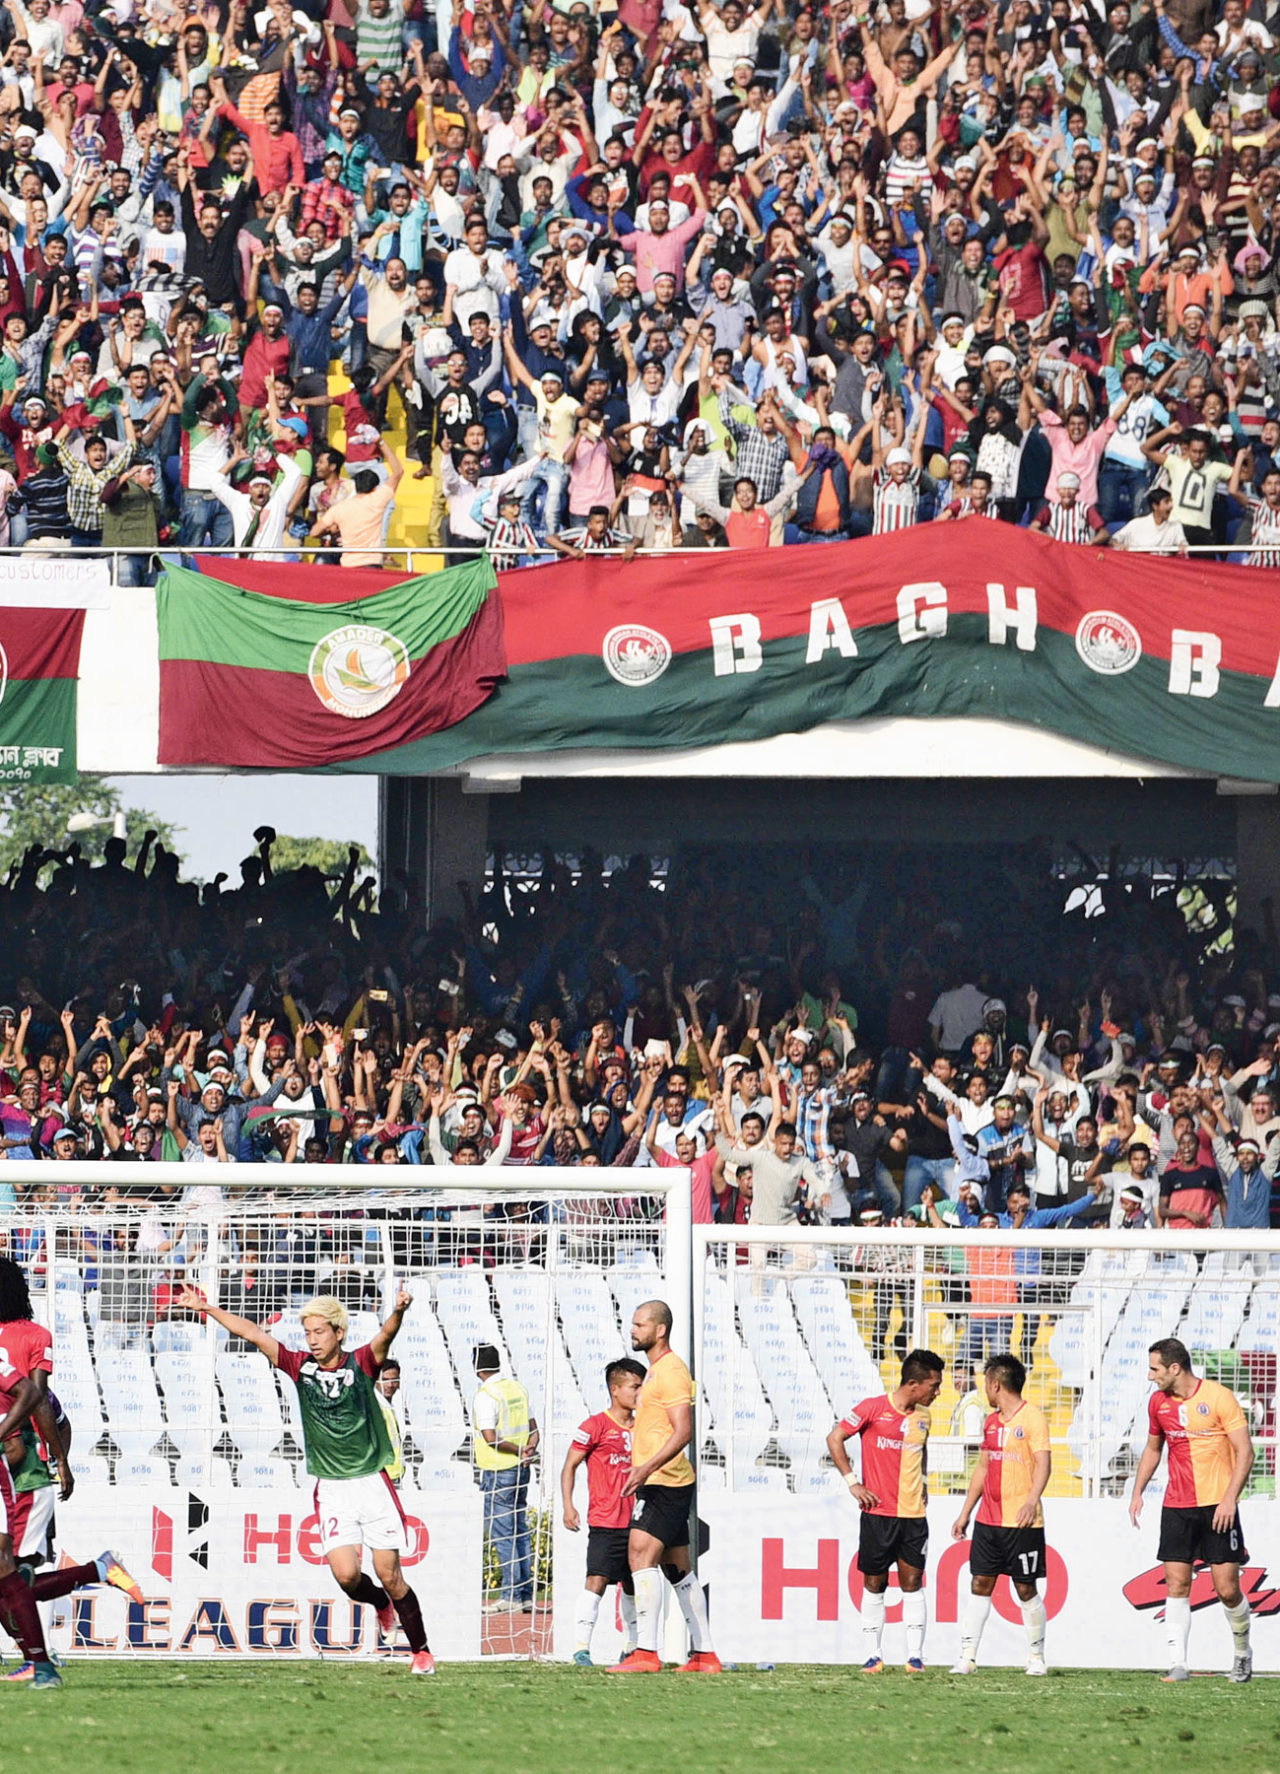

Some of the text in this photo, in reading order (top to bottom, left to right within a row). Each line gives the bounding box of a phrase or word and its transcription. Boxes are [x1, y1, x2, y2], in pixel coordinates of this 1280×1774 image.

[708, 582, 1038, 678] BAGH
[899, 1417, 909, 1436] 4
[1178, 1404, 1189, 1427] 6
[997, 1427, 1011, 1447] 17
[244, 1513, 431, 1567] Heo
[1229, 1529, 1238, 1551] 6
[1018, 1550, 1039, 1576] 17
[51, 1595, 412, 1657] -LEAGU
